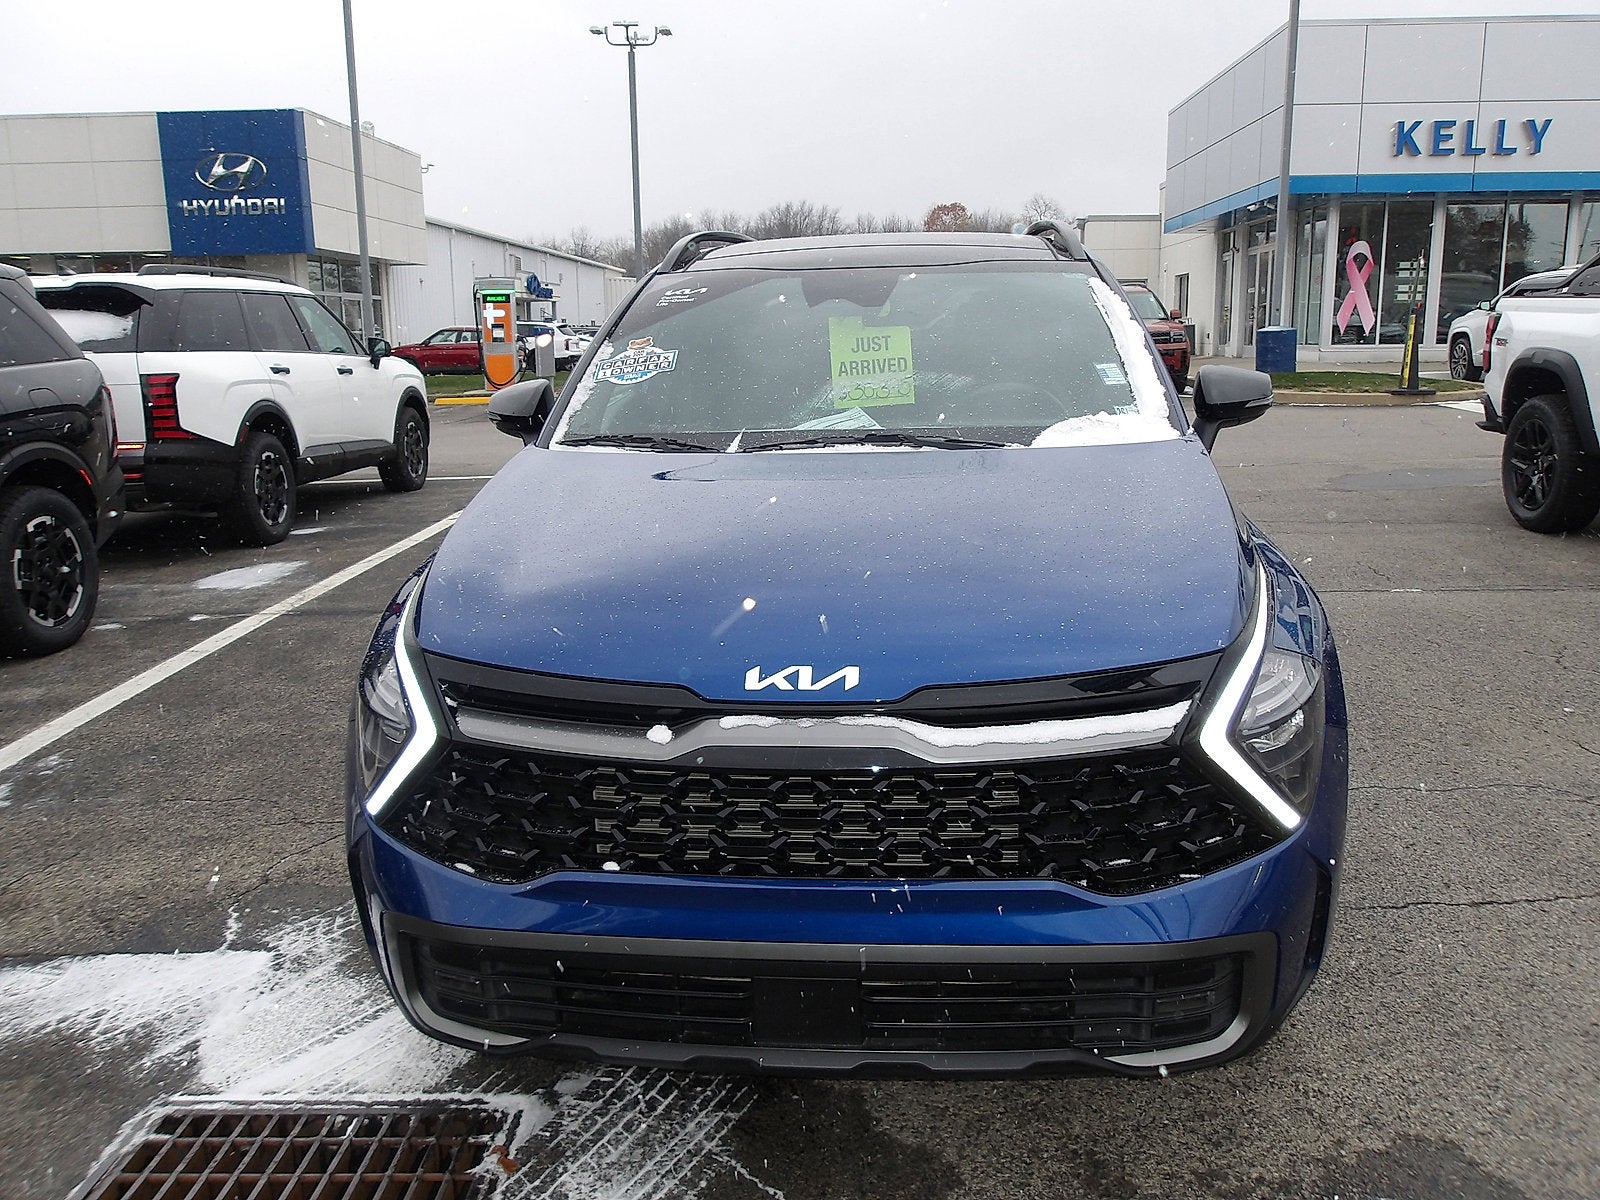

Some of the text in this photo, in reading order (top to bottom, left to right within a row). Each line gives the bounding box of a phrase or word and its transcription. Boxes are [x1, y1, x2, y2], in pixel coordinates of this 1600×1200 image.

[1393, 118, 1553, 157] KELLY
[182, 195, 286, 217] HYUNDAI
[851, 335, 891, 353] JUST
[601, 354, 671, 371] CARFAX
[611, 361, 670, 375] OWNER
[838, 356, 908, 377] ARRIVED
